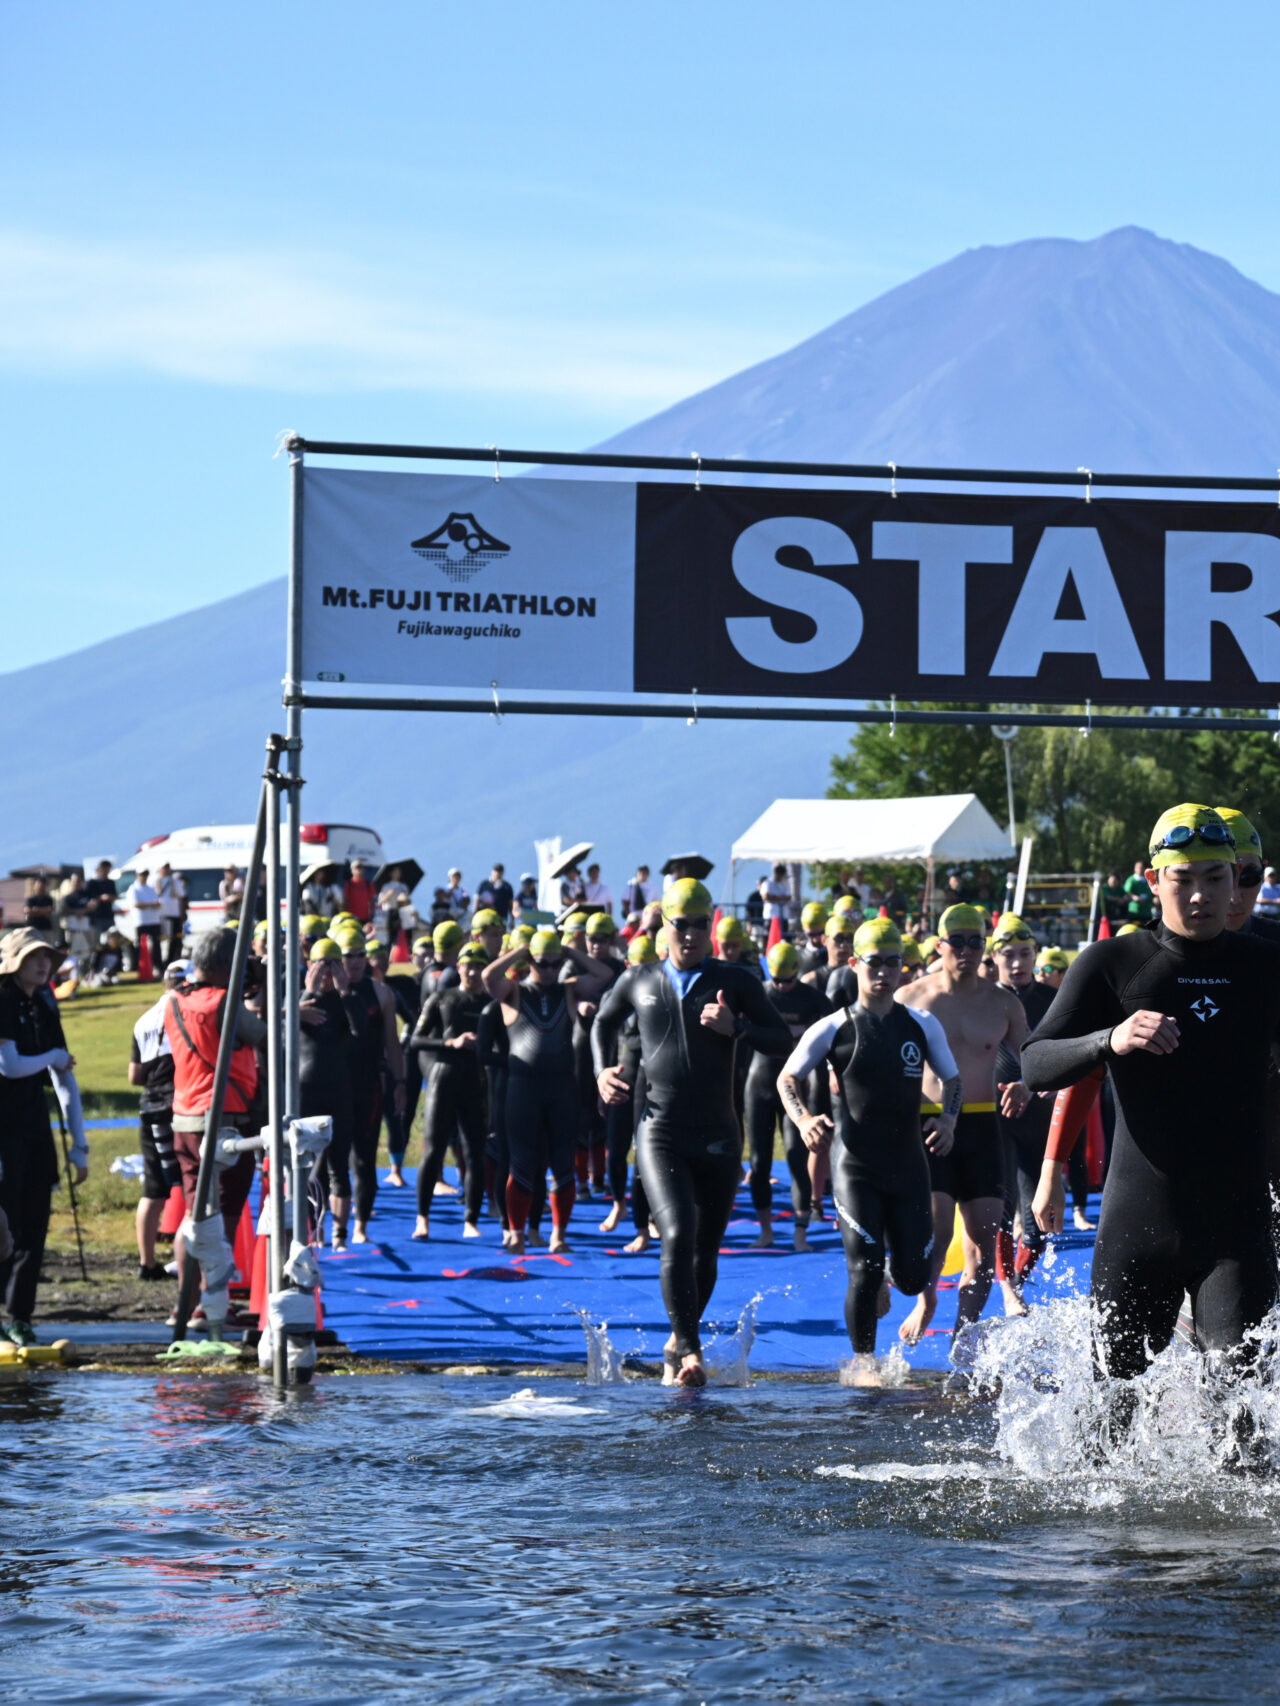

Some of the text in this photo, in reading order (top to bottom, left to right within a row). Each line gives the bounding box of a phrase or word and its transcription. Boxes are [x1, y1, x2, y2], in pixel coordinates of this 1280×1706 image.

[322, 586, 597, 617] Mt.FUJI TRIATHLON
[397, 620, 521, 639] Fujikawaguchiko
